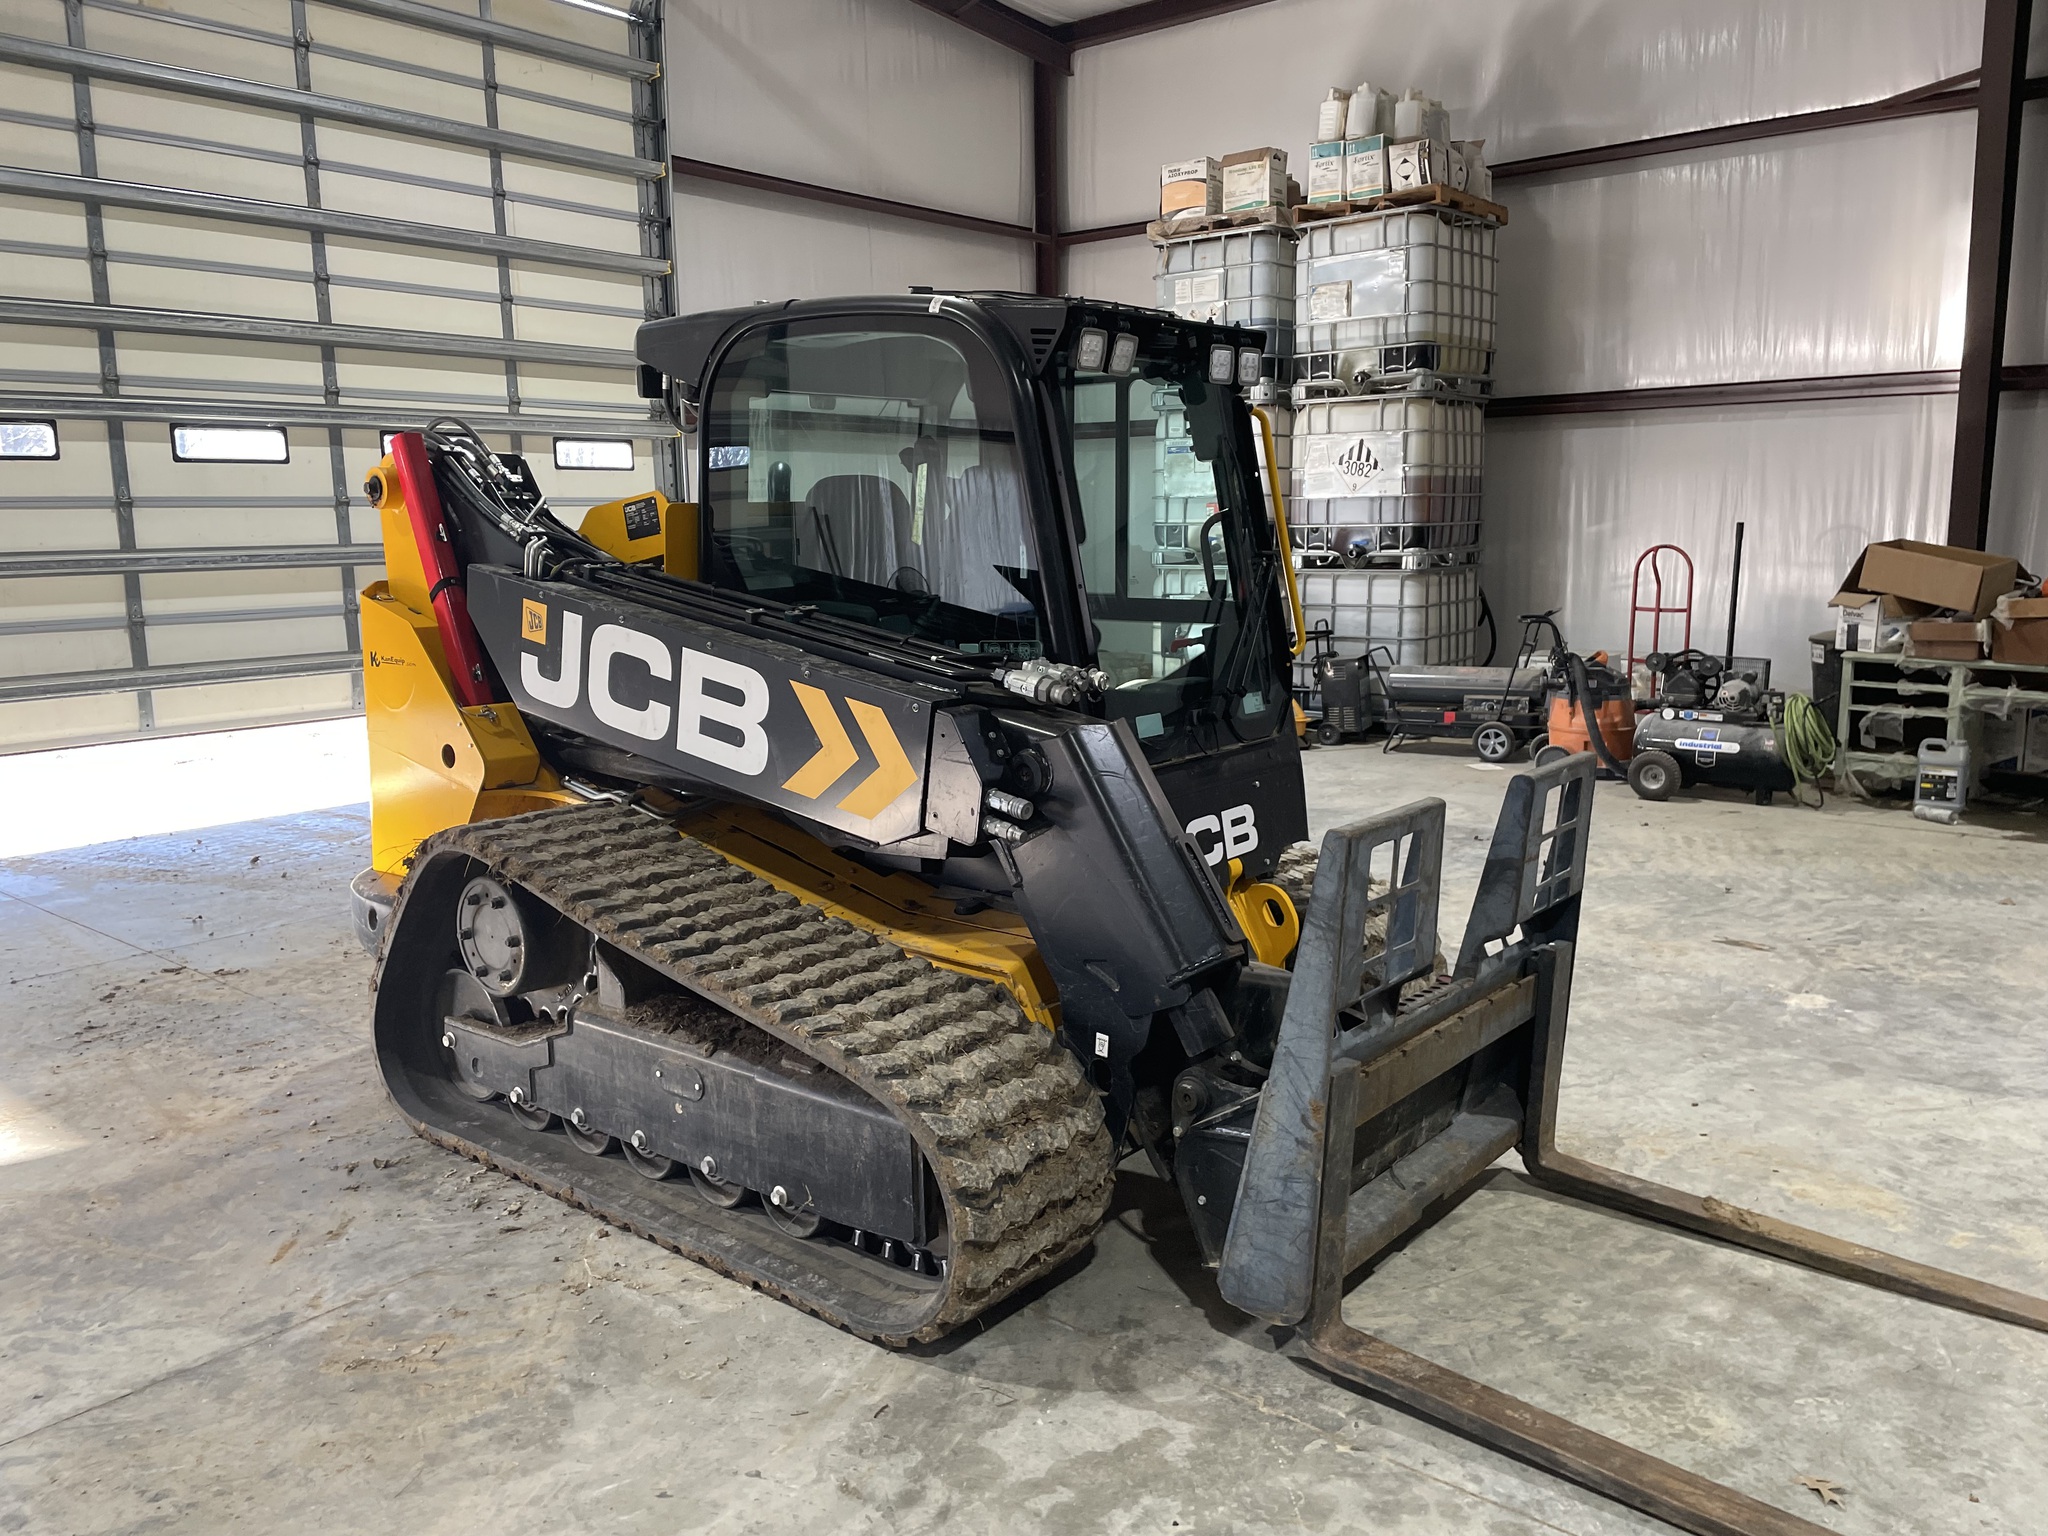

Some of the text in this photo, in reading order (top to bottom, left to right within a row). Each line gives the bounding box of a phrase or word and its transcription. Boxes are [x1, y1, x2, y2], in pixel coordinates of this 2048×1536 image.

[1167, 169, 1198, 179] AZOXYPROP
[1342, 460, 1372, 478] 3082
[1352, 483, 1357, 491] 9
[624, 505, 636, 513] JCB
[1842, 608, 1864, 619] Delvac
[527, 610, 543, 630] JCB
[520, 610, 769, 775] JCB
[1679, 740, 1722, 750] industrial
[1185, 803, 1259, 867] CB
